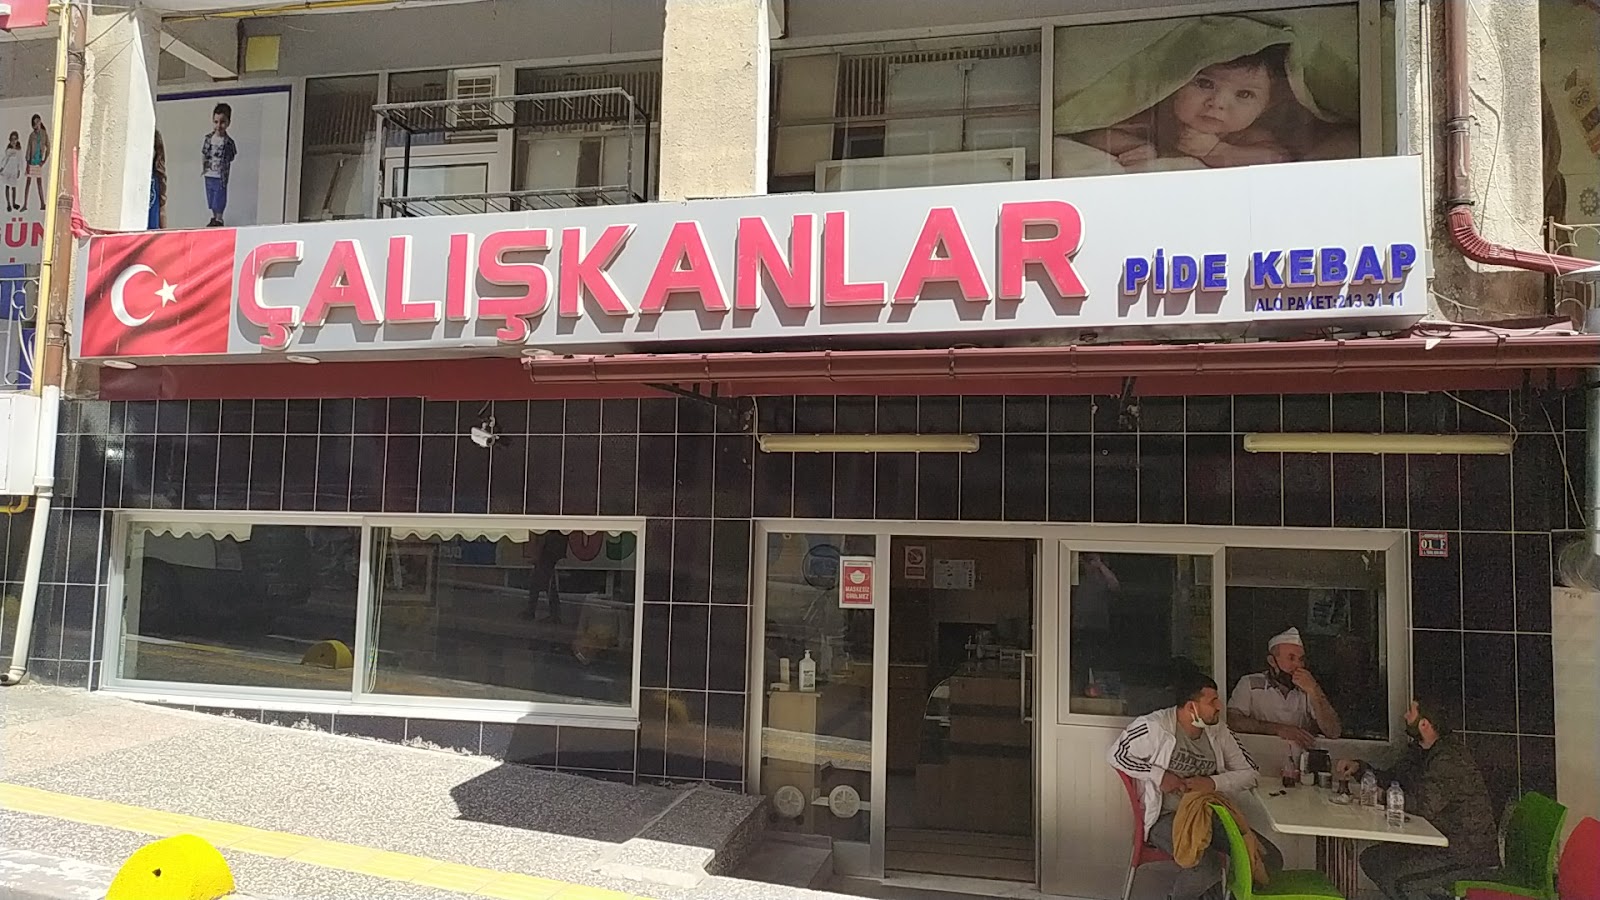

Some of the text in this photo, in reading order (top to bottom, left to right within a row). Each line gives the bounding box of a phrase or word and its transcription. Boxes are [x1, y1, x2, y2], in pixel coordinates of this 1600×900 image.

[238, 200, 1089, 350] ÇALIŞKANLAR
[1124, 243, 1416, 295] PİDE KEBAP
[1256, 297, 1283, 312] ALO
[1367, 293, 1383, 308] 31
[1388, 292, 1403, 307] 11
